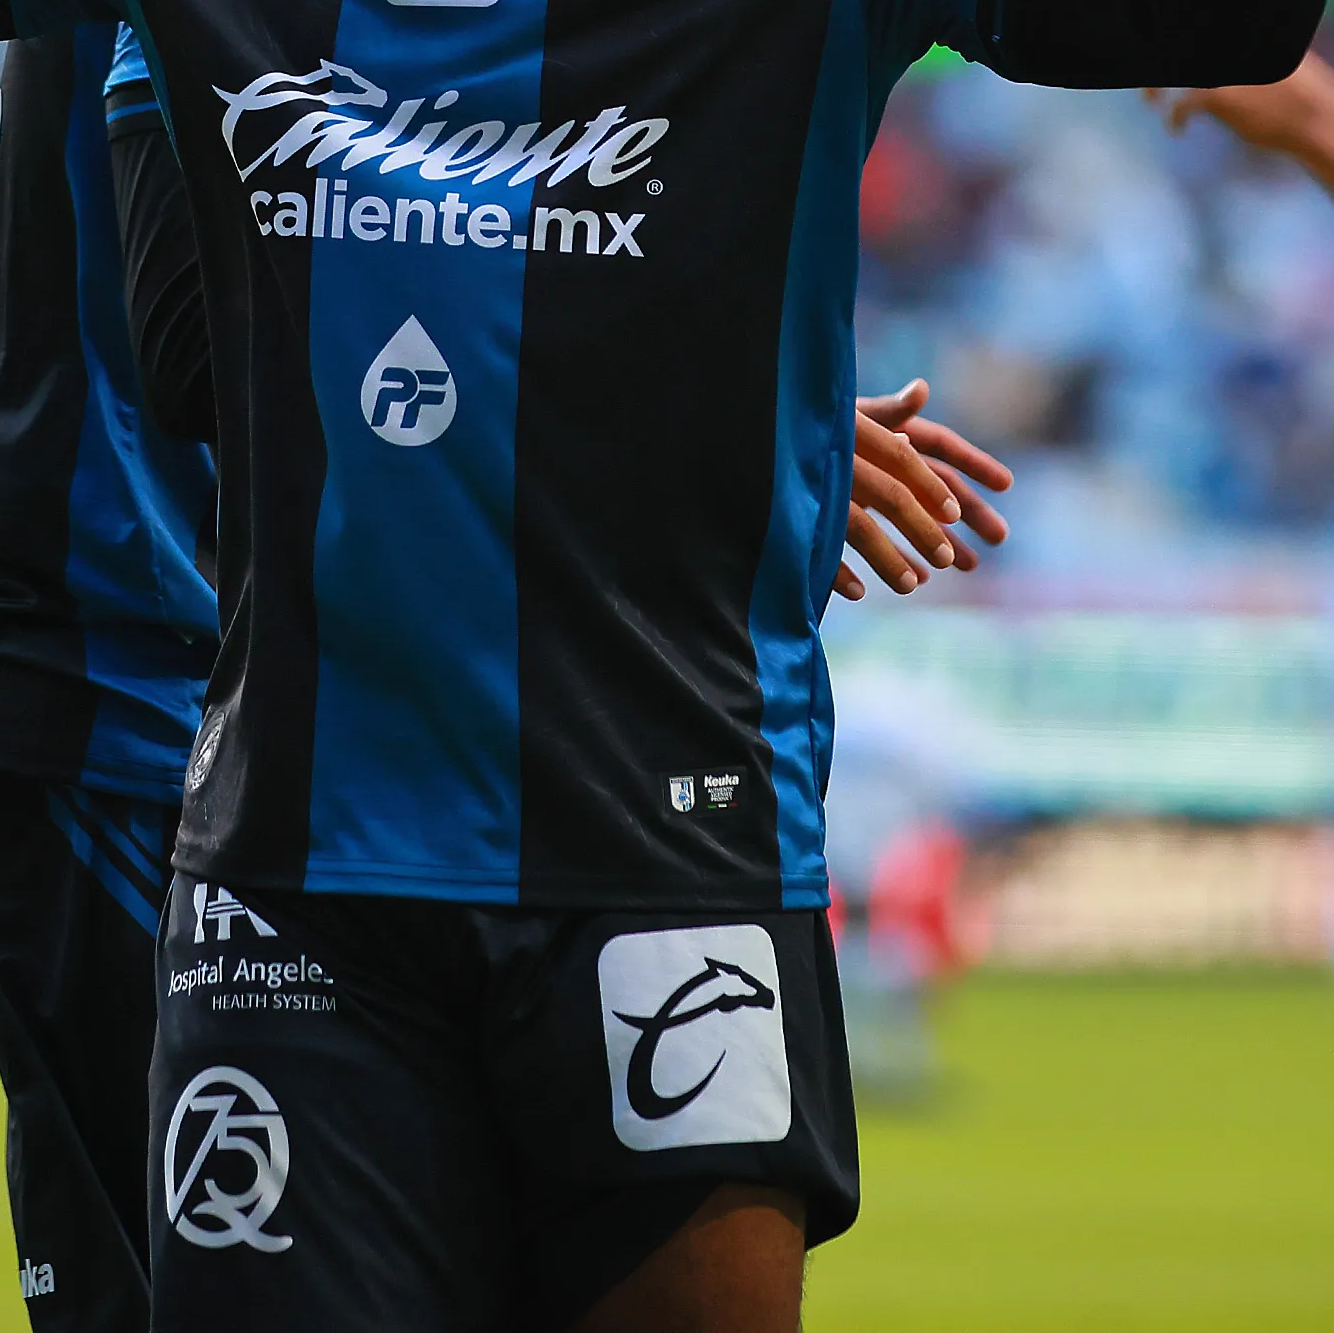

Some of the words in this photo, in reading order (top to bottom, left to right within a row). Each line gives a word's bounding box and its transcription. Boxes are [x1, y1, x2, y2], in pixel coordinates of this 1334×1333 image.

[212, 59, 670, 188] Caliente
[250, 177, 647, 258] caliente.mx
[370, 366, 451, 430] PF
[212, 993, 267, 1011] HEALTH
[273, 992, 336, 1013] SYSTEM
